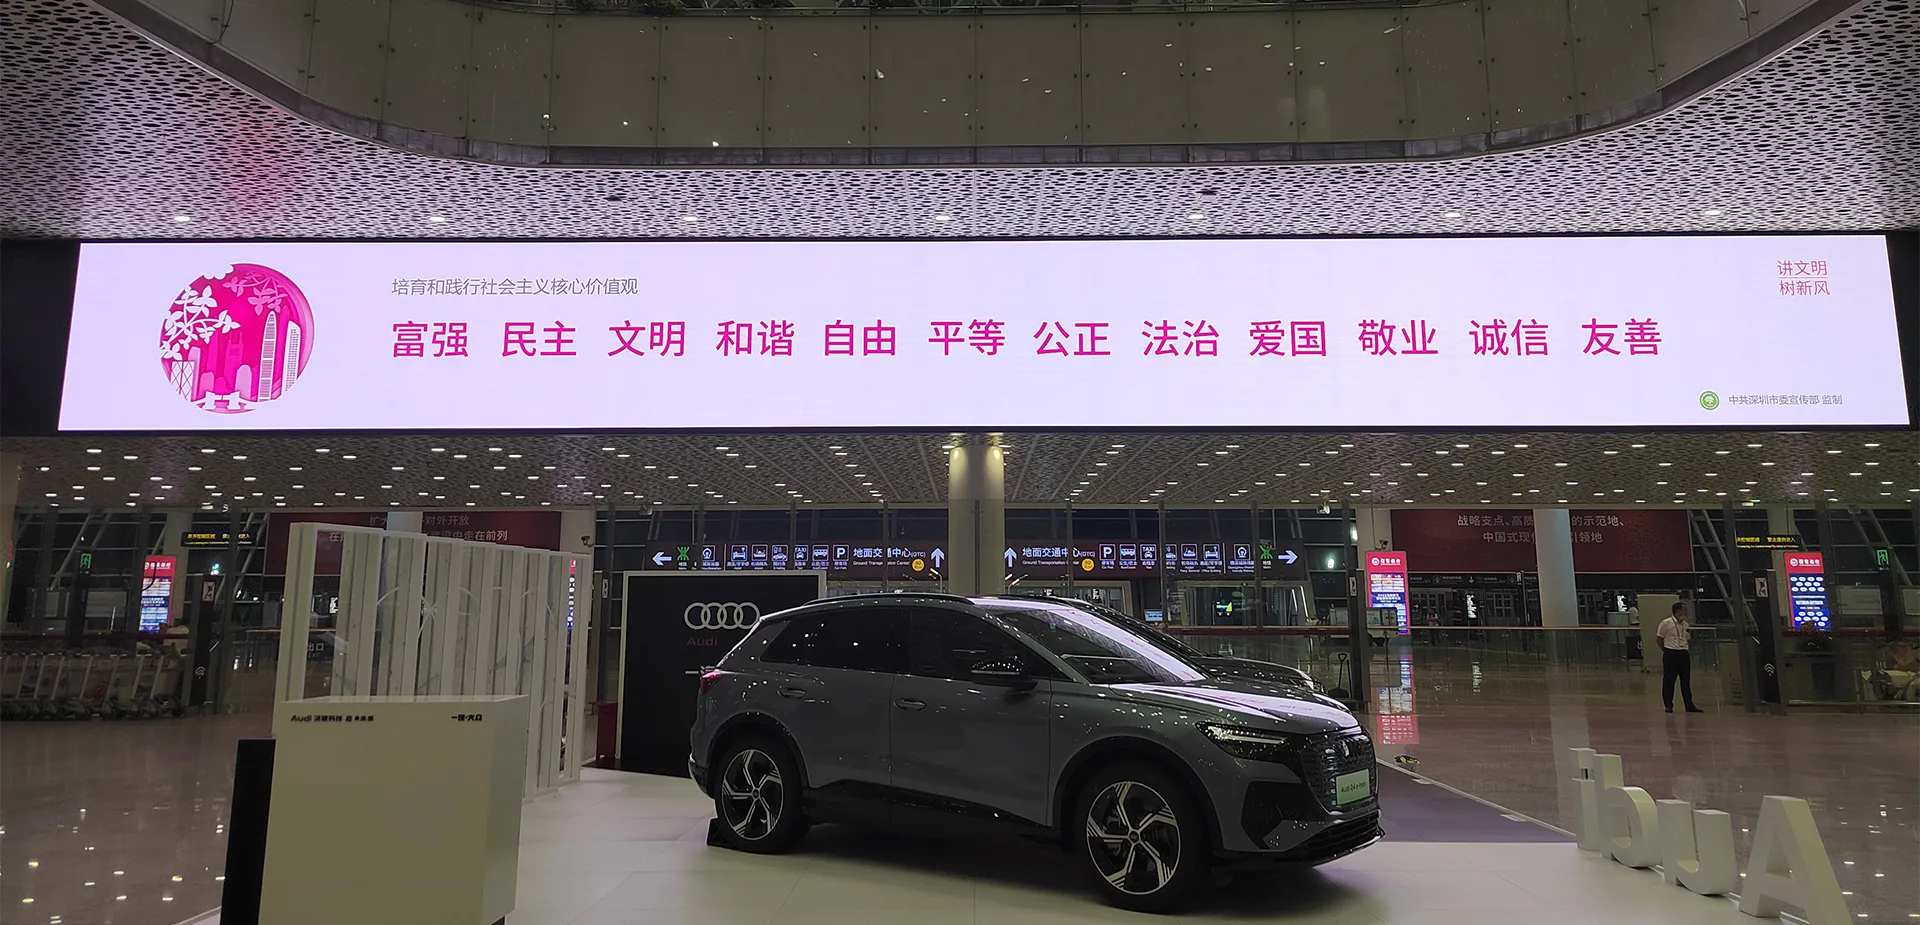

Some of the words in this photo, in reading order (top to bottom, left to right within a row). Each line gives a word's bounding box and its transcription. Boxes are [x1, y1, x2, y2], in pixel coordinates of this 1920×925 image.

[1777, 260, 1828, 276] 讲文明
[391, 277, 639, 296] 培育和践行社会主义核心价值观
[1779, 280, 1831, 296] 树新风
[393, 321, 468, 357] 富强
[502, 321, 576, 357] 民主
[608, 320, 685, 356] 文明
[716, 320, 794, 356] 和谐
[825, 320, 895, 356] 自由
[929, 319, 1005, 356] 平等
[1034, 322, 1110, 356] 公正
[1142, 320, 1219, 356] 法治
[1250, 320, 1326, 356] 爱国
[1358, 320, 1438, 356] 敬业
[1469, 319, 1548, 356] 诚信
[1582, 318, 1661, 356] 友善
[1728, 394, 1819, 405] 中共深圳市委宣传部
[1822, 394, 1842, 405] 监制
[686, 637, 718, 647] Audi
[290, 714, 312, 722] Audi
